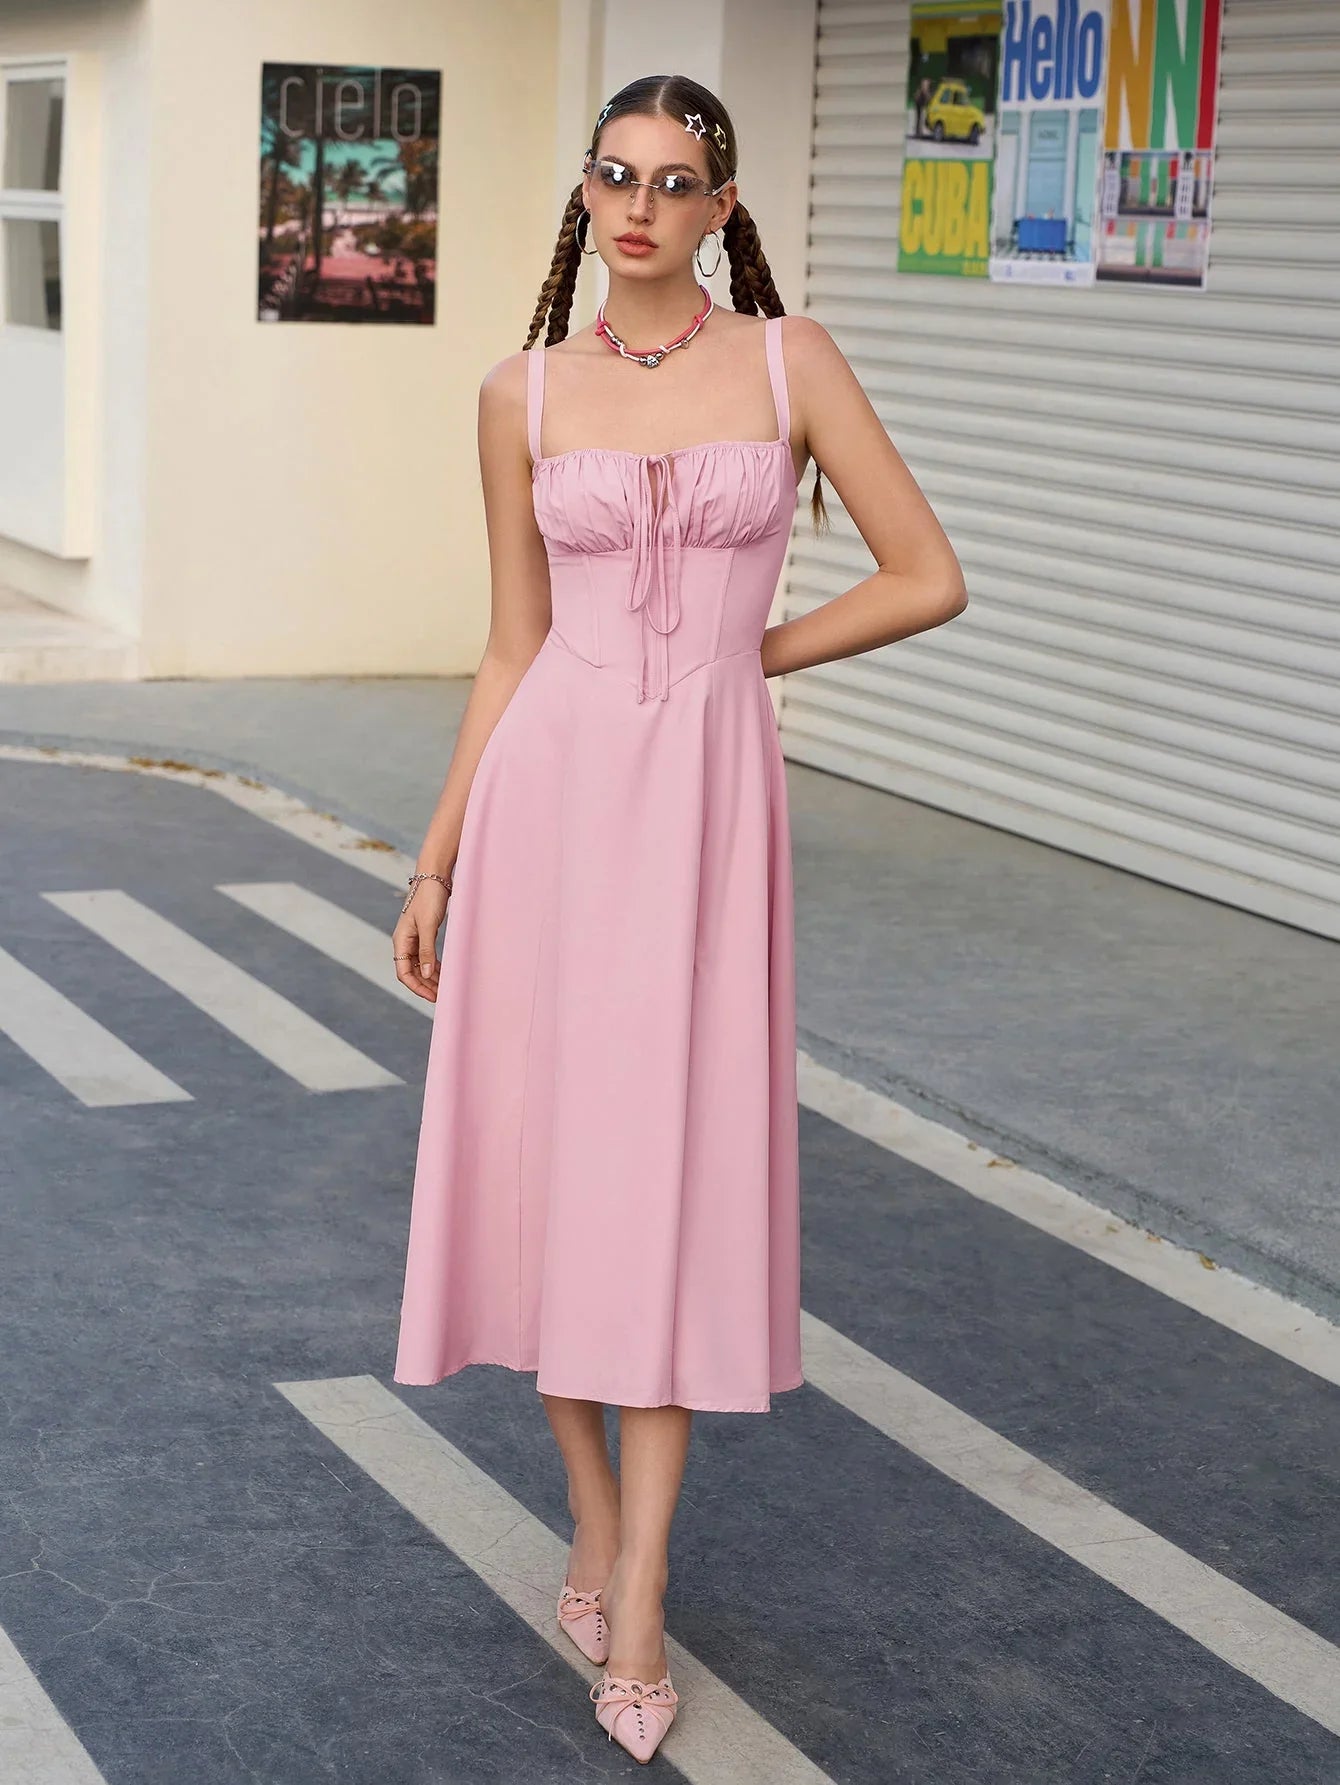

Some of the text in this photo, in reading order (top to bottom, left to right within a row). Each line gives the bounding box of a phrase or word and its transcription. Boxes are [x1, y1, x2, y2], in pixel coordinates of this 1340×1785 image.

[1003, 0, 1103, 101] Hello
[279, 67, 423, 142] cielo
[901, 160, 988, 257] CUBA
